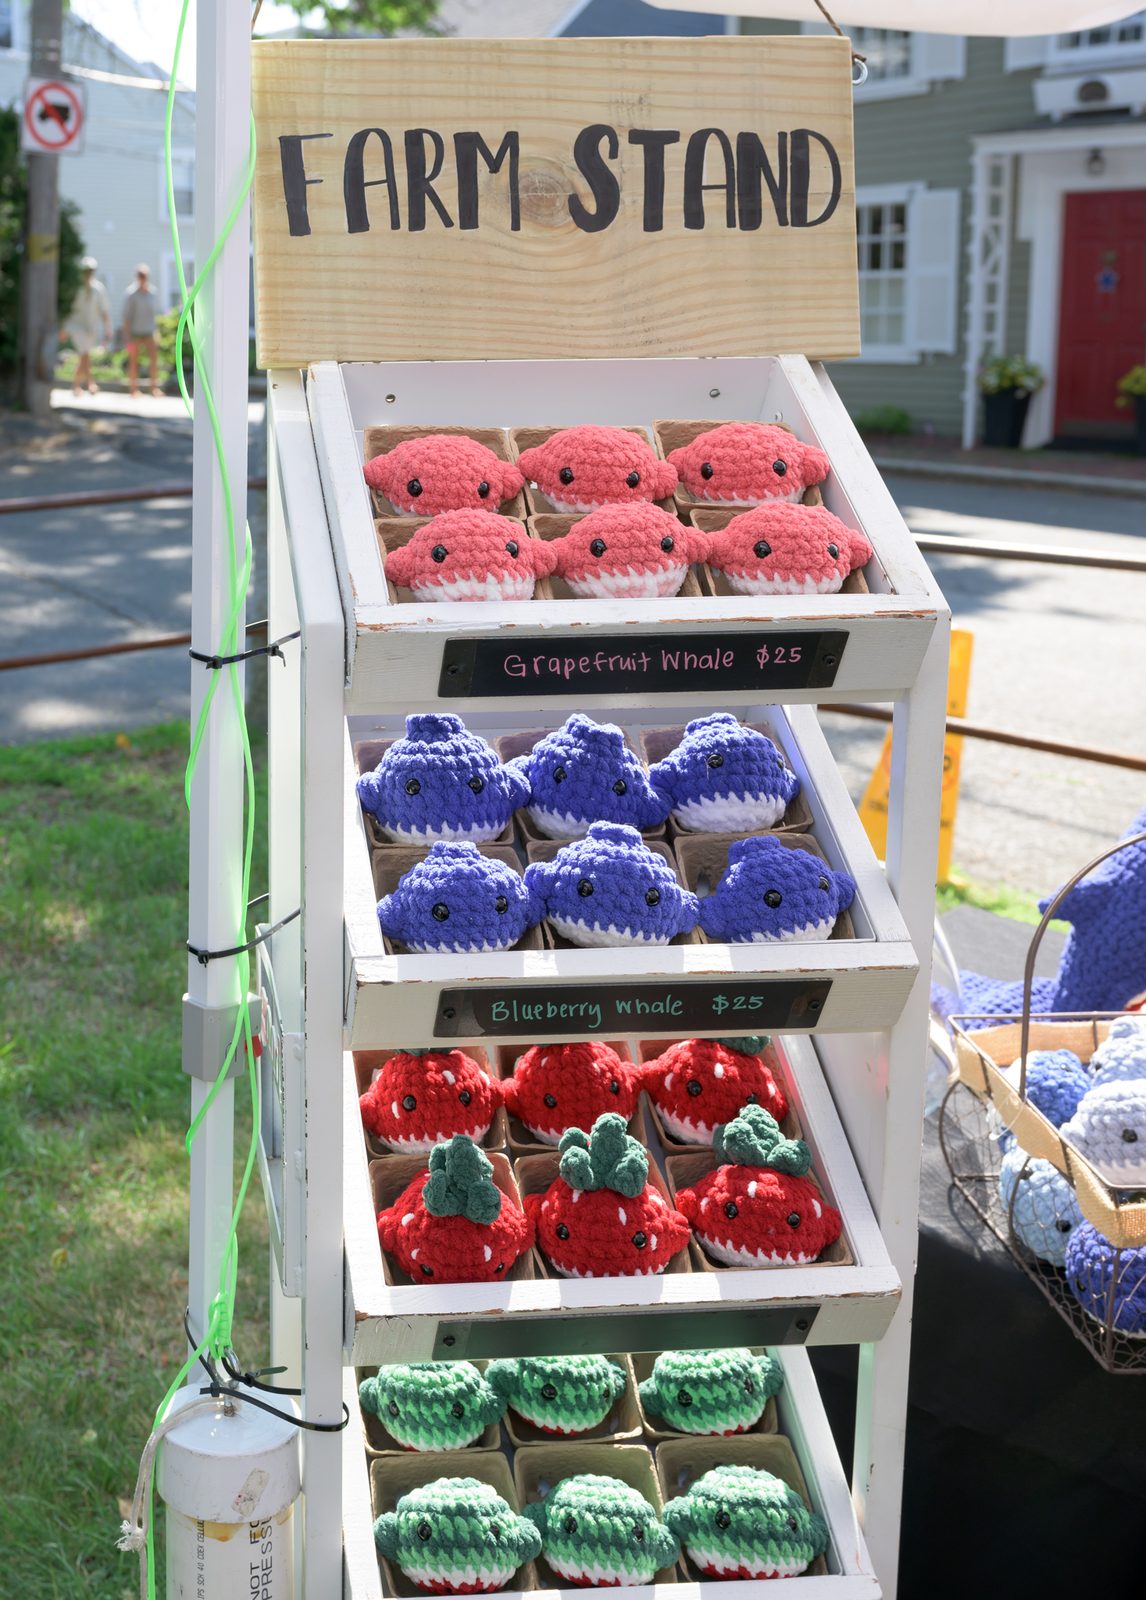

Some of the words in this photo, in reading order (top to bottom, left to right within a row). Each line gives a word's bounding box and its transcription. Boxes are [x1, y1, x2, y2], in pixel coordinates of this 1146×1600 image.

[278, 127, 521, 236] FARM
[568, 123, 842, 233] STAND
[503, 648, 652, 680] Grapefruit
[661, 647, 735, 672] Whale
[756, 645, 803, 670] $25
[490, 999, 602, 1028] Blueberry
[711, 994, 765, 1016] $25
